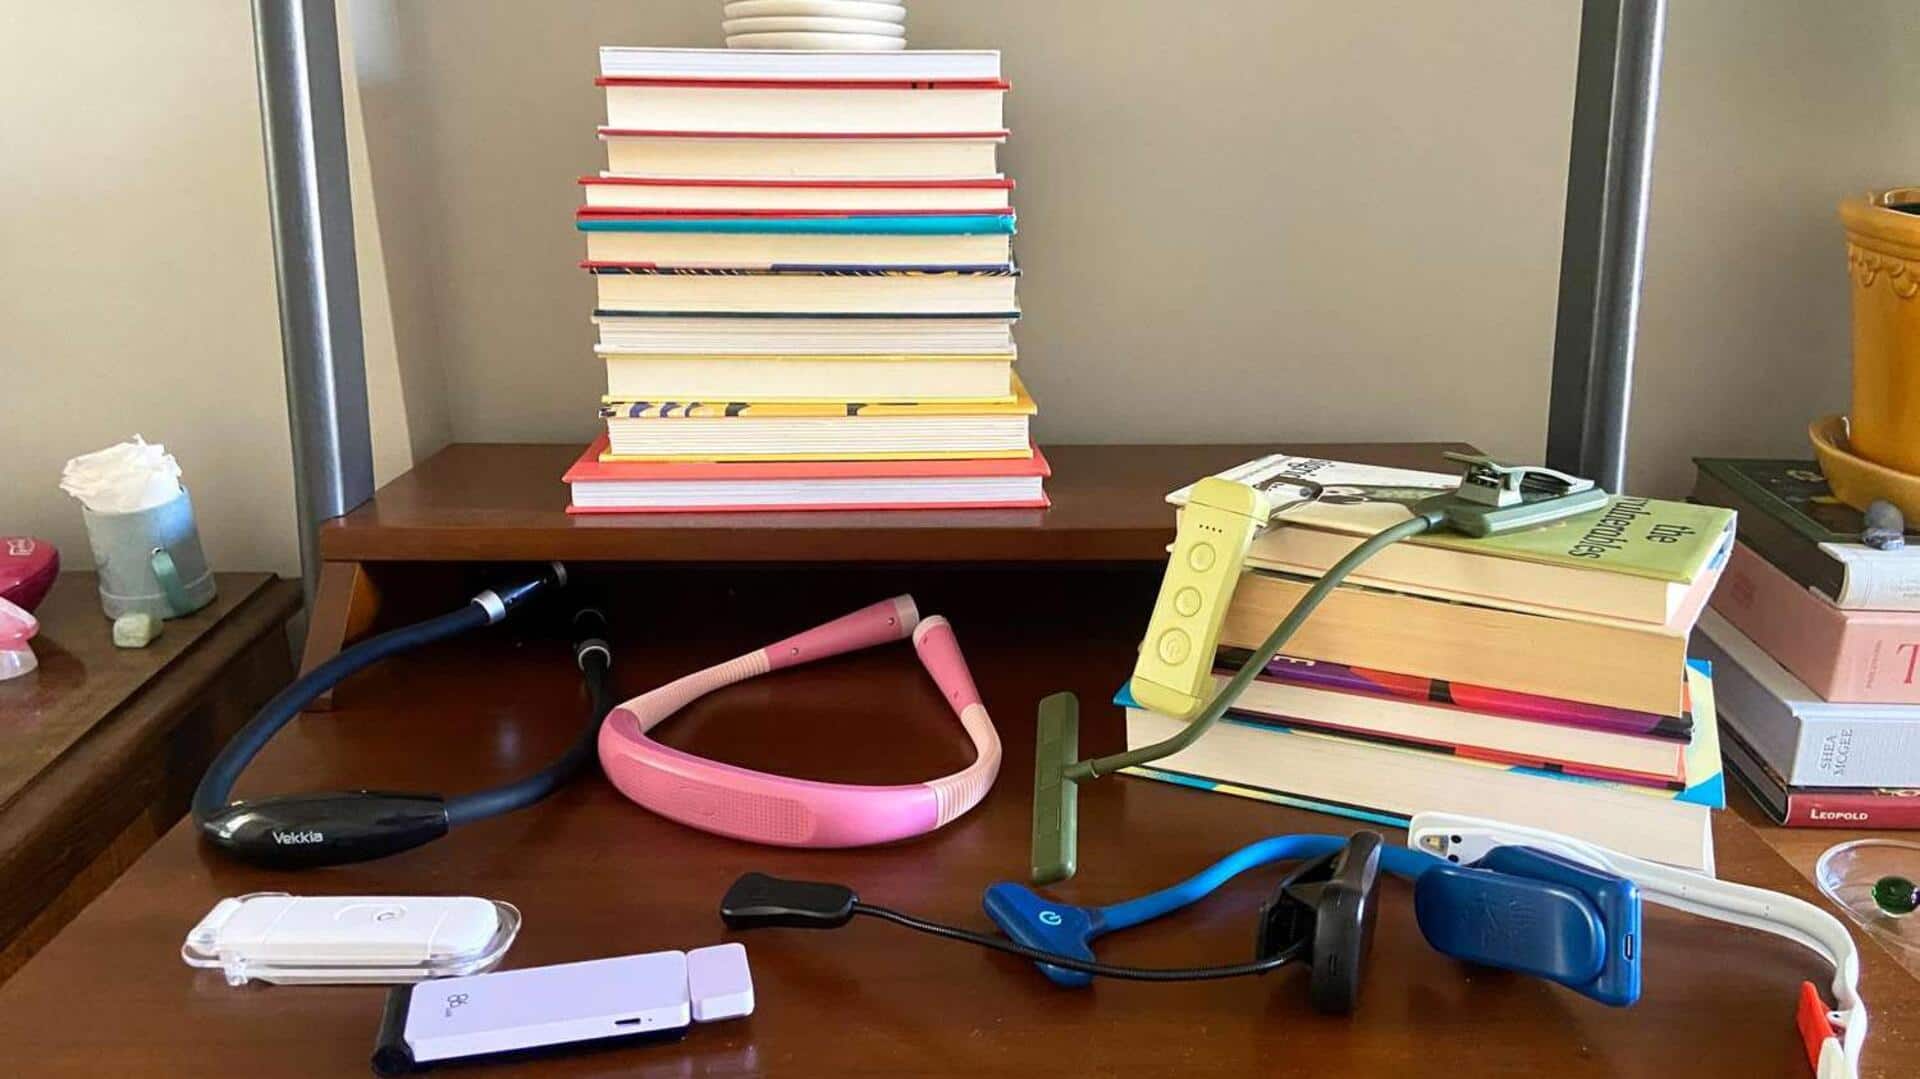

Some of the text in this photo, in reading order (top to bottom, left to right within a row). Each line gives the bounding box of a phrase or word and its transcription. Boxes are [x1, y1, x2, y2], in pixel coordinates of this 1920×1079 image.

[1646, 523, 1695, 544] the
[1820, 735, 1837, 769] SHEA
[272, 831, 323, 845] Vekkia
